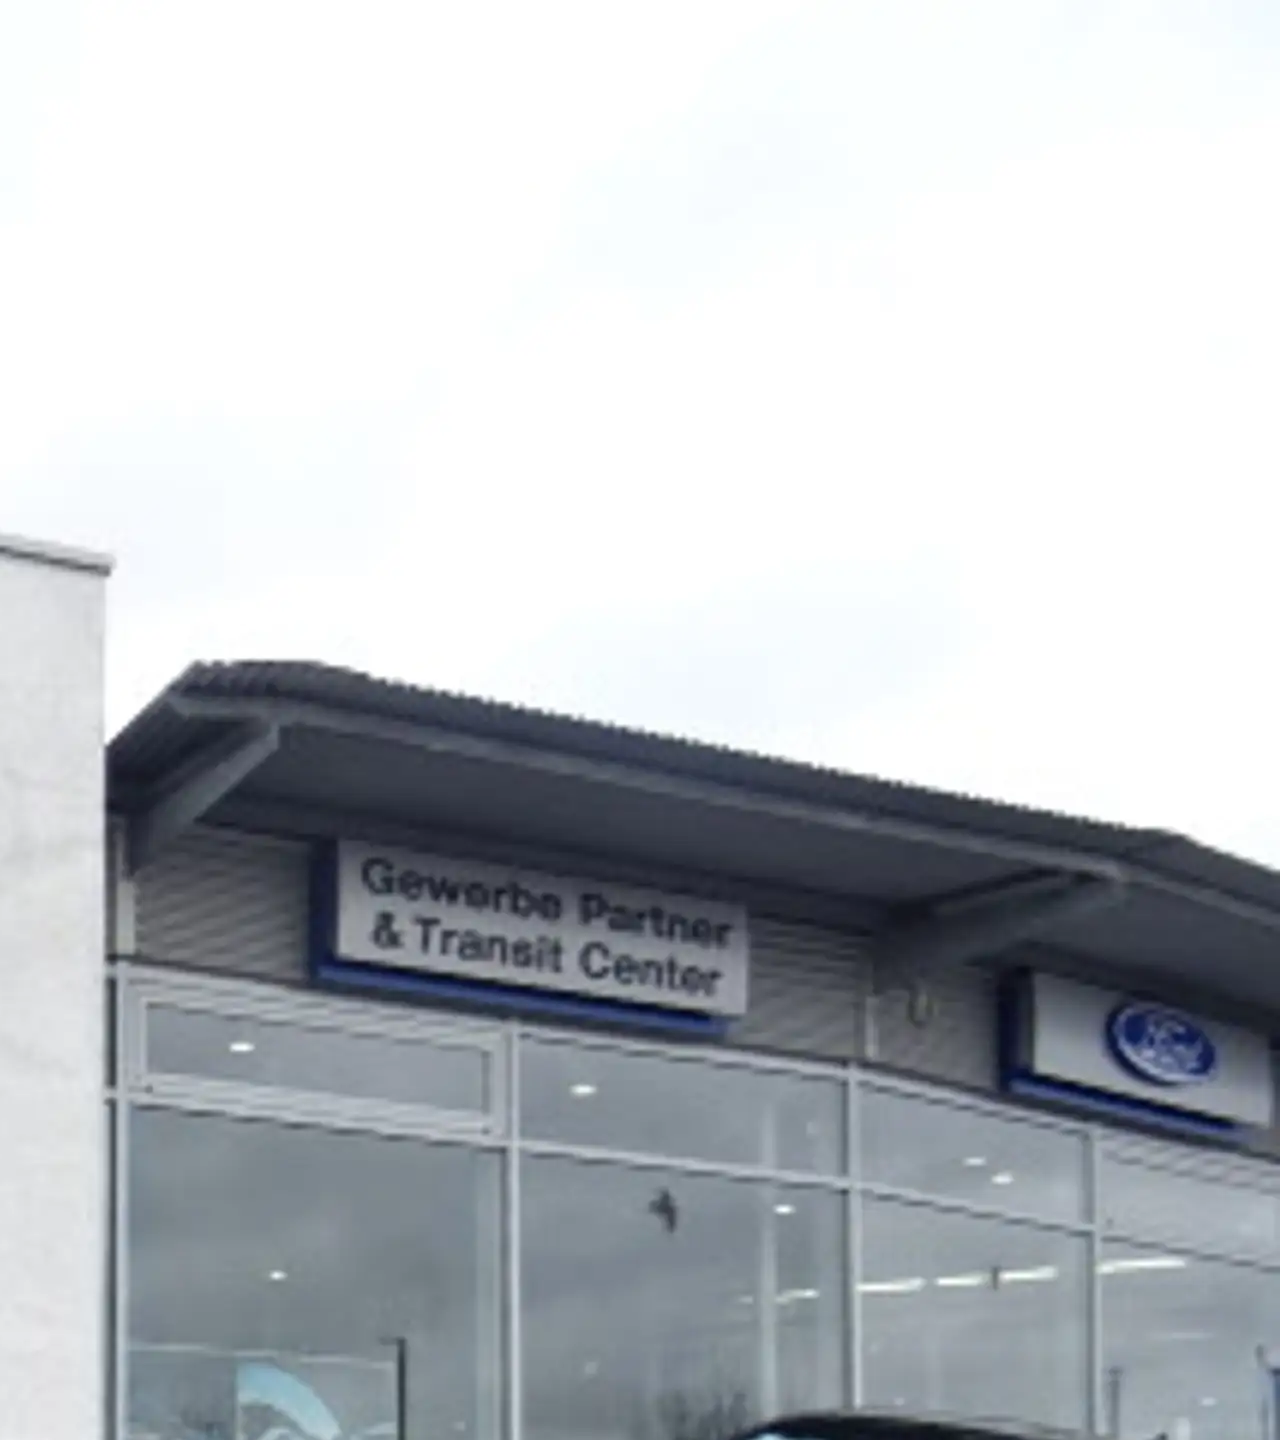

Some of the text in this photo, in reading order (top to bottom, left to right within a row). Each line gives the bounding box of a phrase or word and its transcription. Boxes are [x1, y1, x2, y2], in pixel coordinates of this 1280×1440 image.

[360, 856, 734, 949] Gewerbe Partner
[370, 910, 726, 998] & Transit Center
